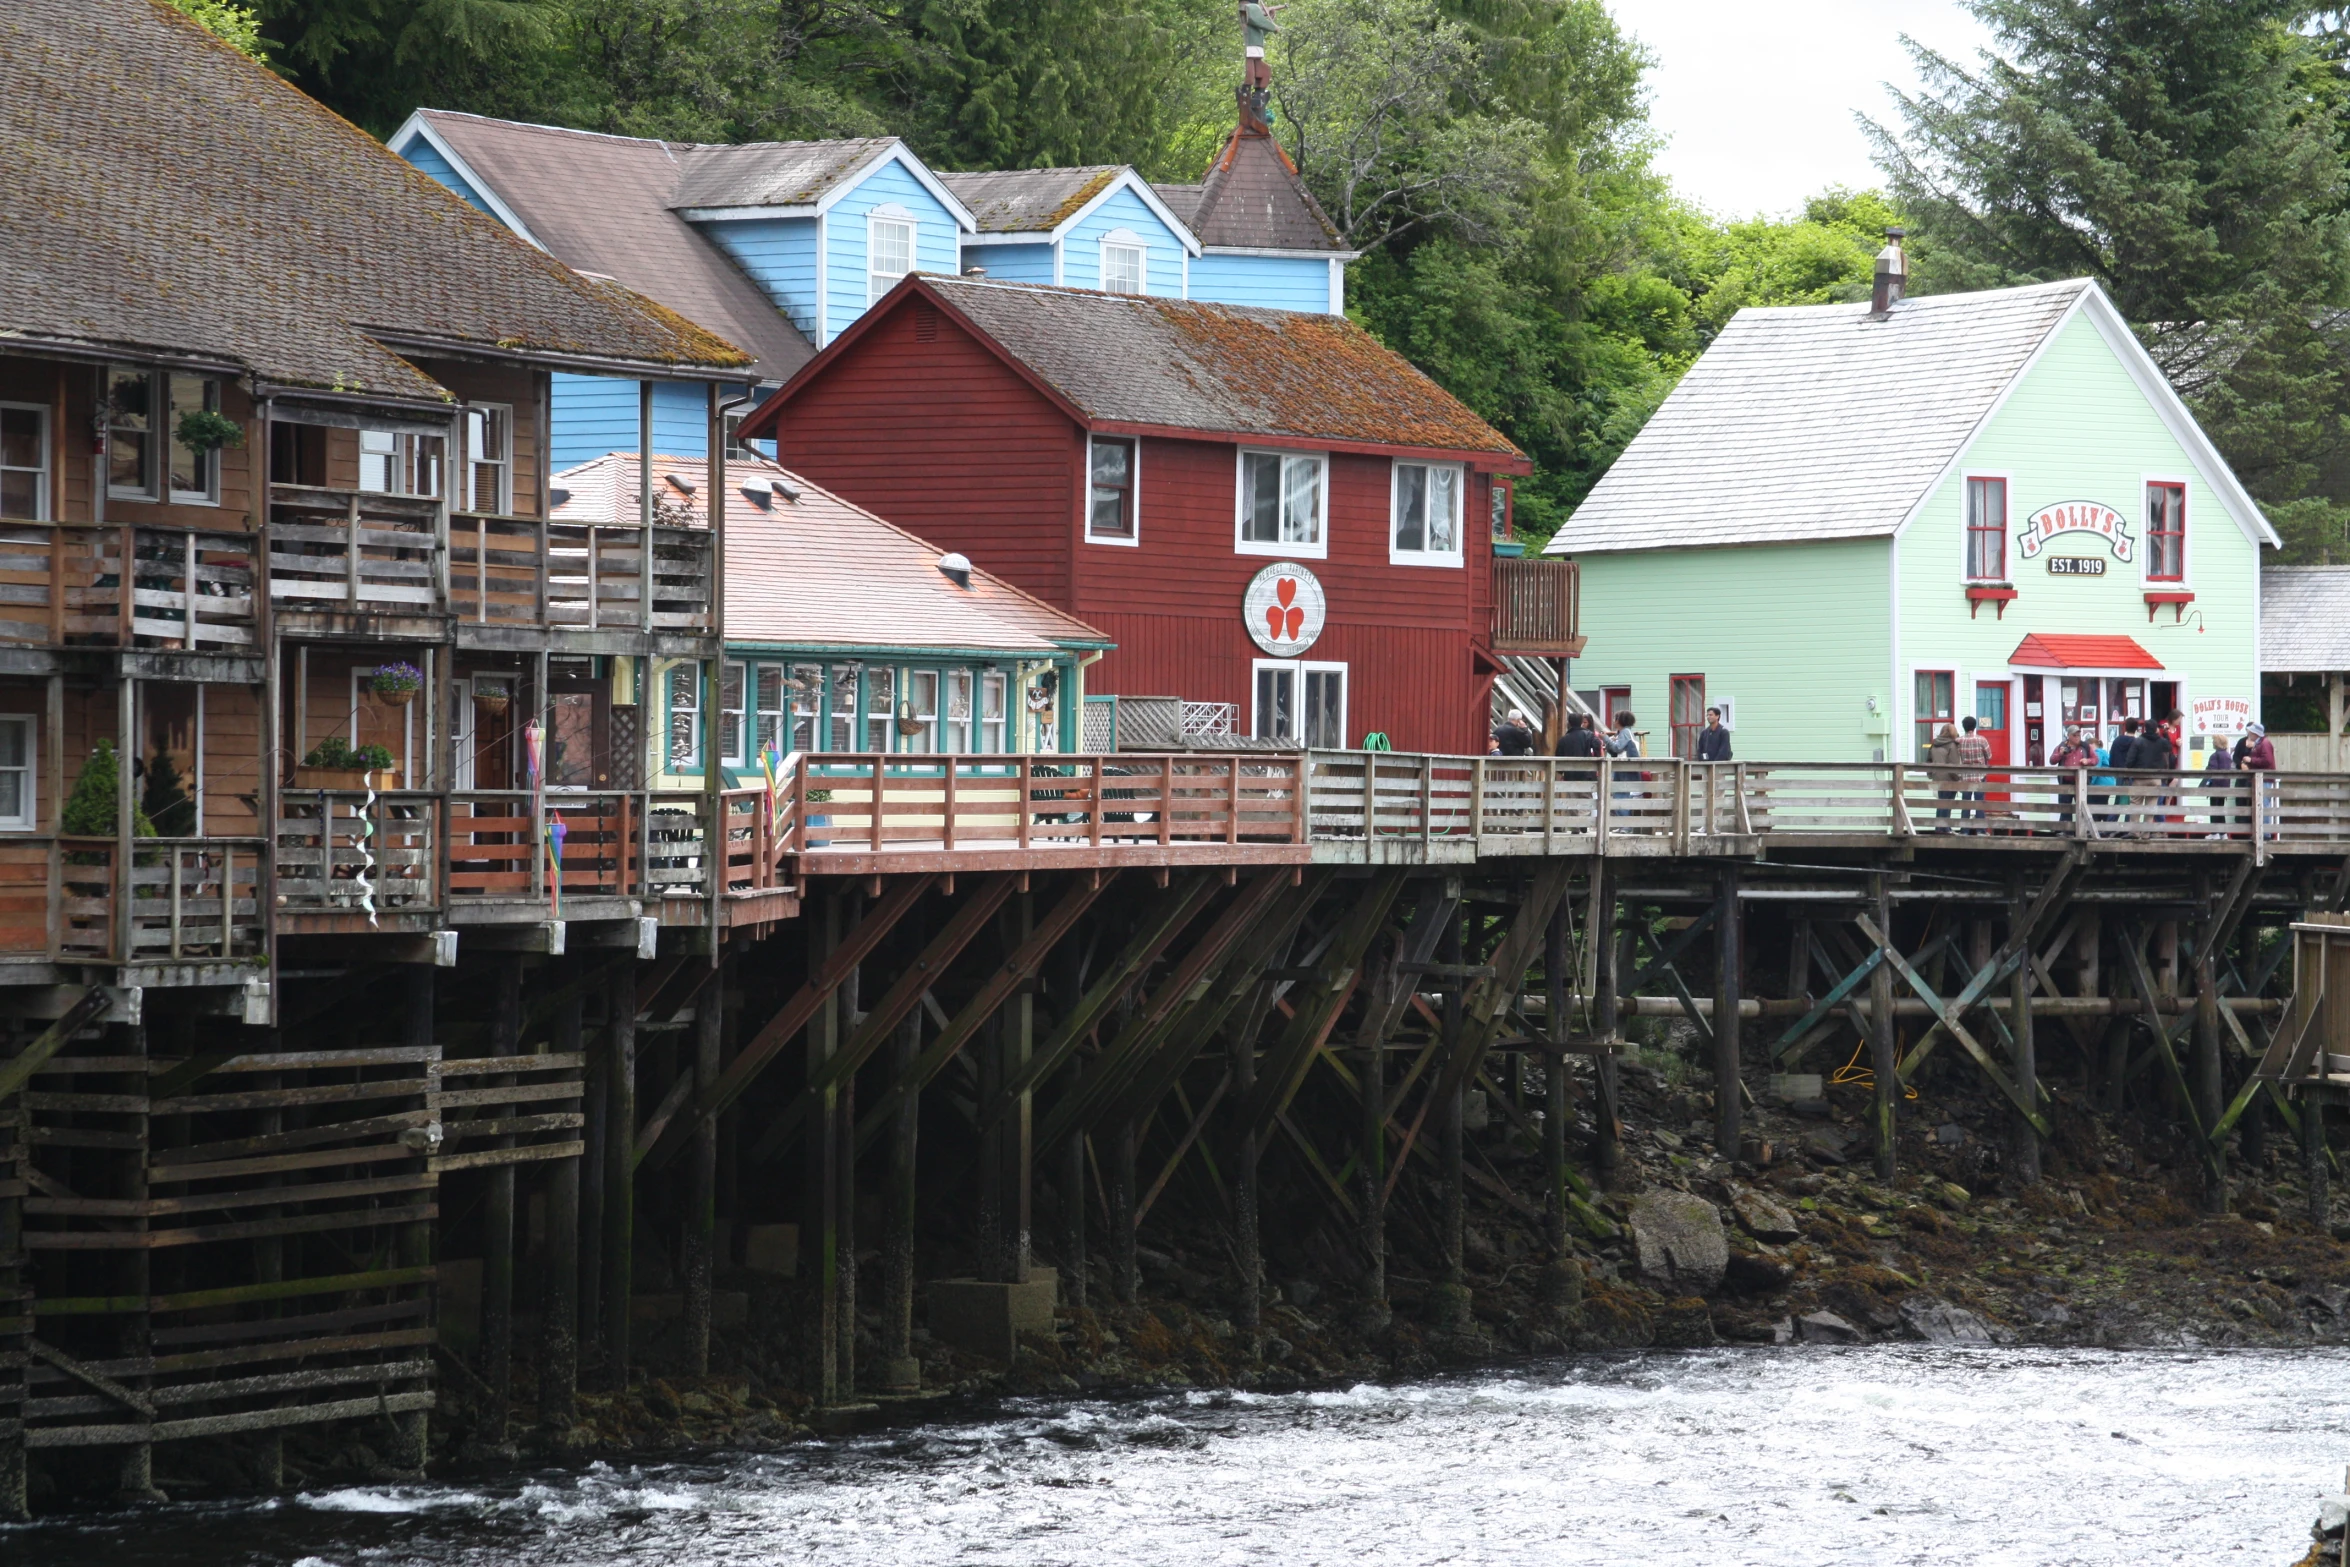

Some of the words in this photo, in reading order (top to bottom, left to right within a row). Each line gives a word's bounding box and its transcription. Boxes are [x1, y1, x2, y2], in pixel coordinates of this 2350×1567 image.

[2040, 506, 2114, 535] DOLLY'S
[1259, 564, 1283, 582] PERFECT
[1288, 564, 1316, 585] PARTNERS
[2051, 558, 2074, 573] EST.
[2078, 559, 2102, 574] 1919
[2194, 699, 2222, 714] DOLLY'S
[2225, 700, 2249, 714] HOUSE
